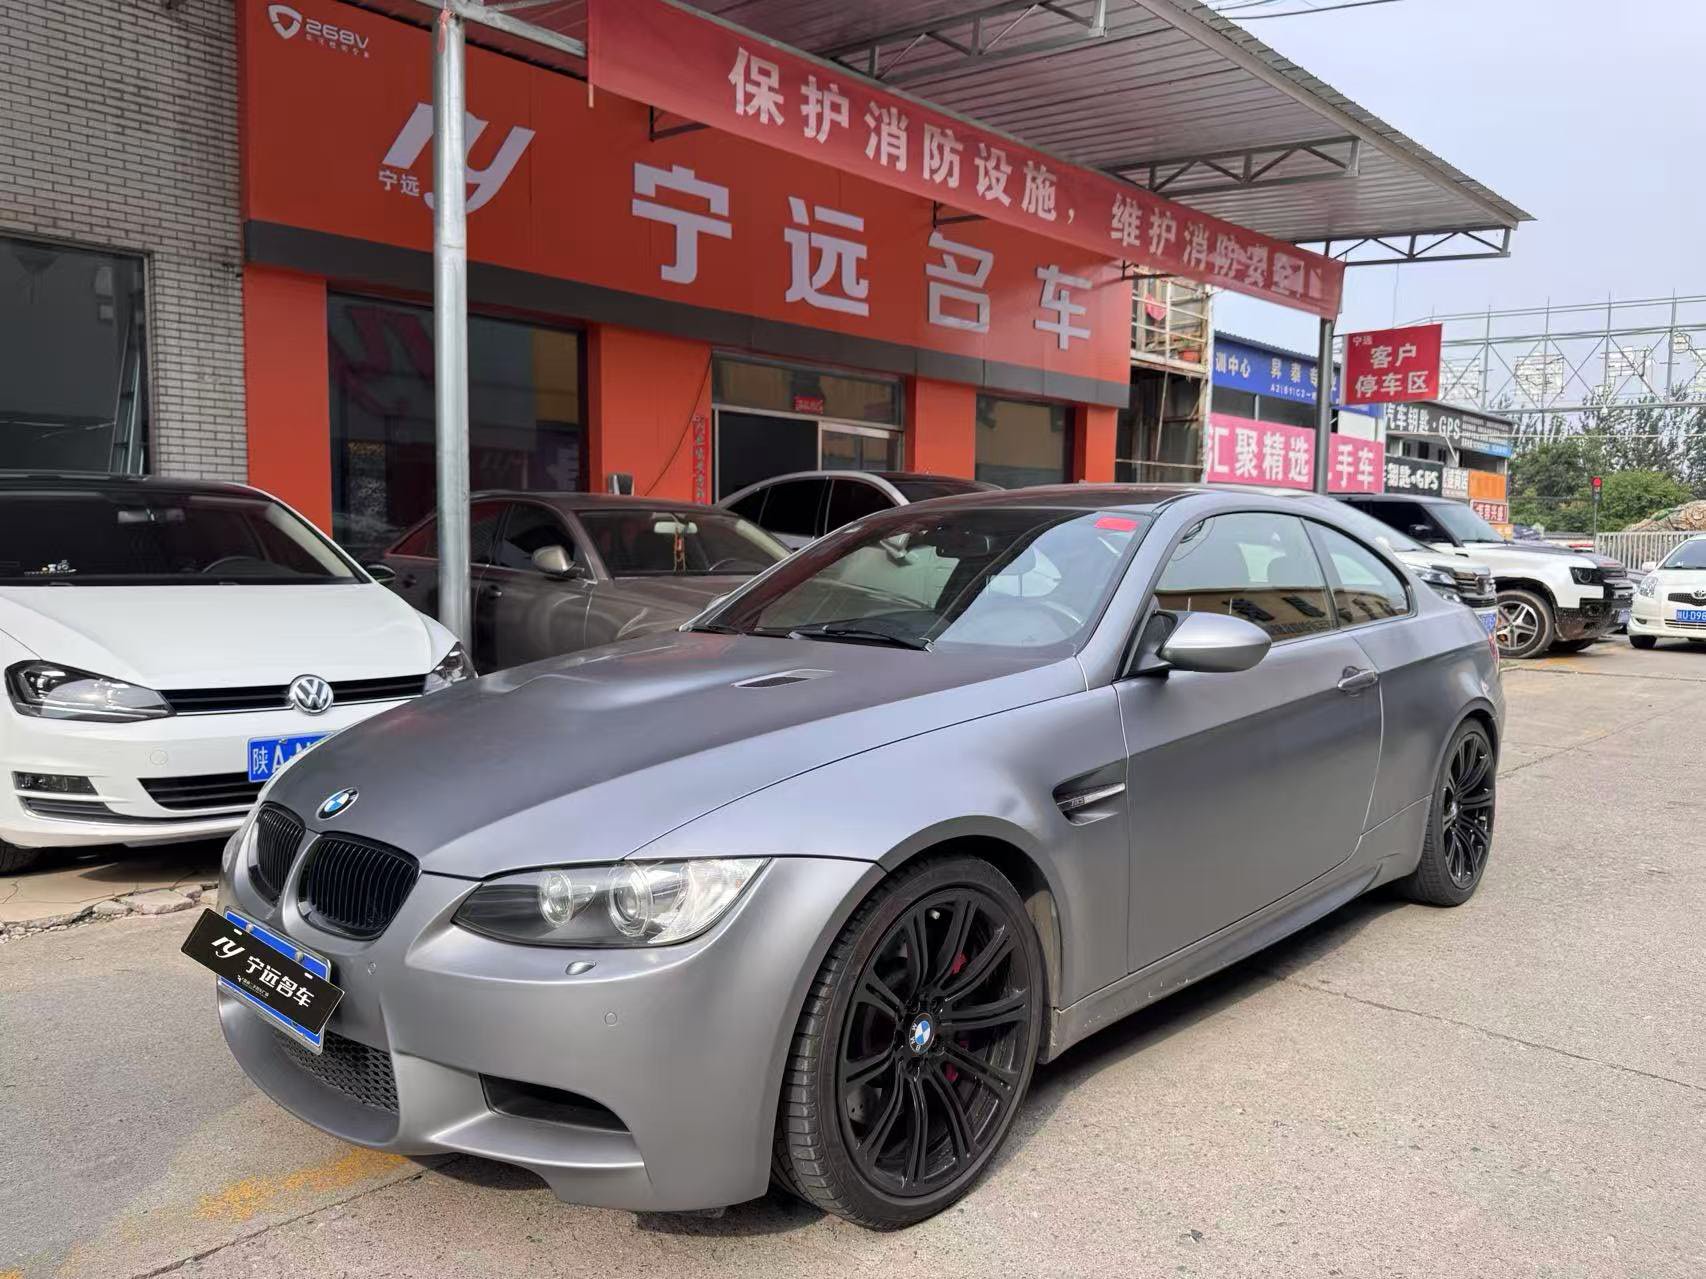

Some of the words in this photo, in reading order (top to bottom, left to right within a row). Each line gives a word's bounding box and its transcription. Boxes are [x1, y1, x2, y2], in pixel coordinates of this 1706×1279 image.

[306, 18, 369, 49] 268V
[378, 169, 420, 197] 宁远
[632, 162, 1093, 351] 宁远名车
[1370, 343, 1417, 369] 客户
[1355, 370, 1429, 399] 停车区
